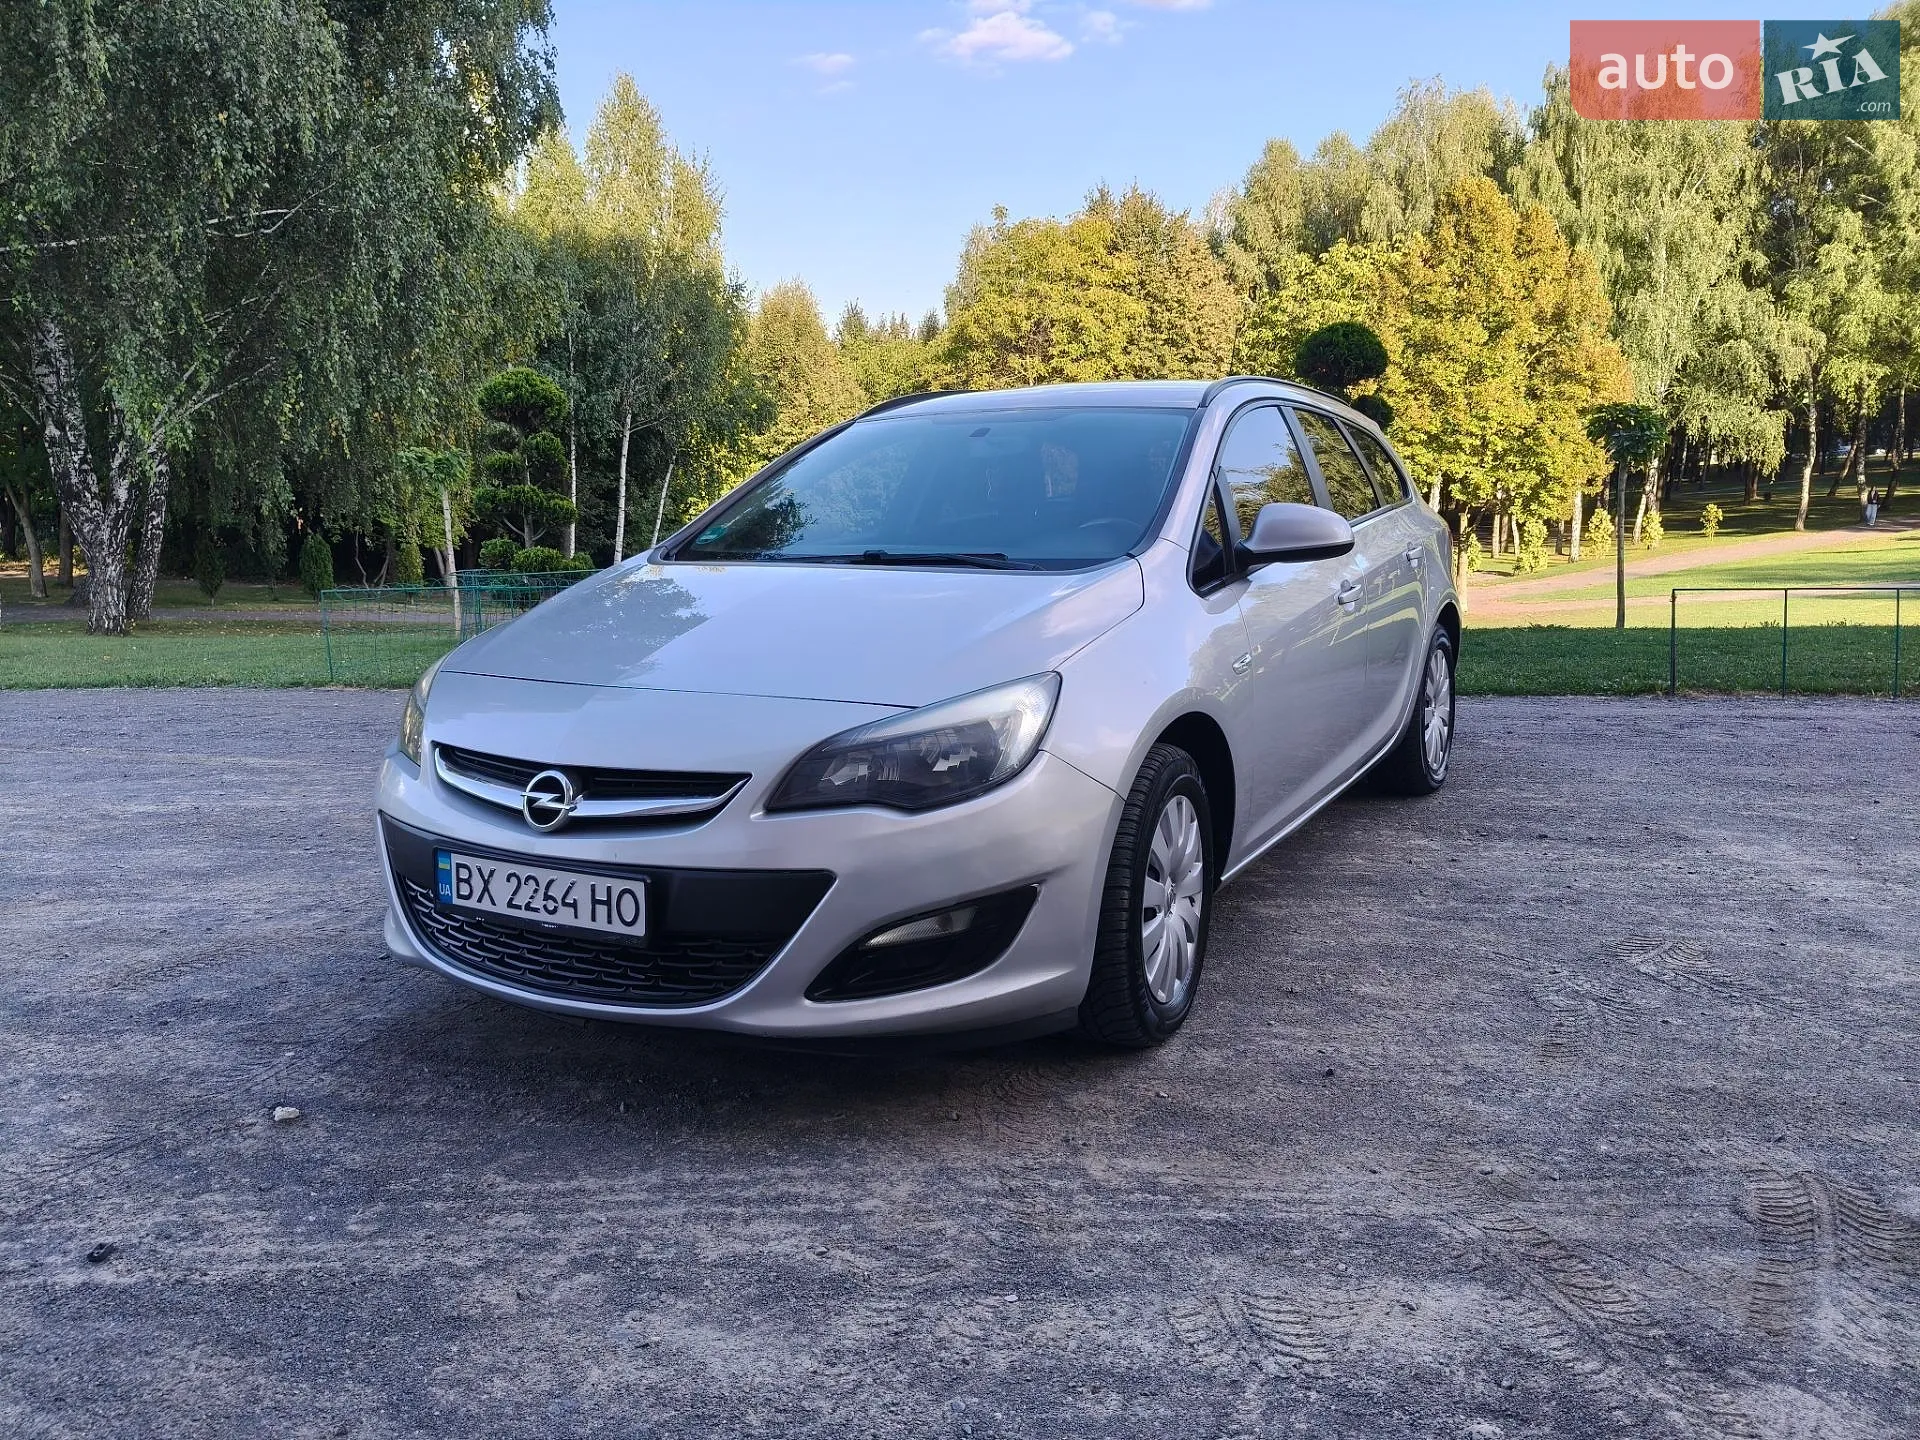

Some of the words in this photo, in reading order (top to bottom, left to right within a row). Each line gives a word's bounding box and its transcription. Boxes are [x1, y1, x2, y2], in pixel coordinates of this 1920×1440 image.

[439, 882, 451, 896] UA
[455, 861, 496, 906] BX
[505, 870, 579, 919] 2264
[590, 881, 641, 927] HO
